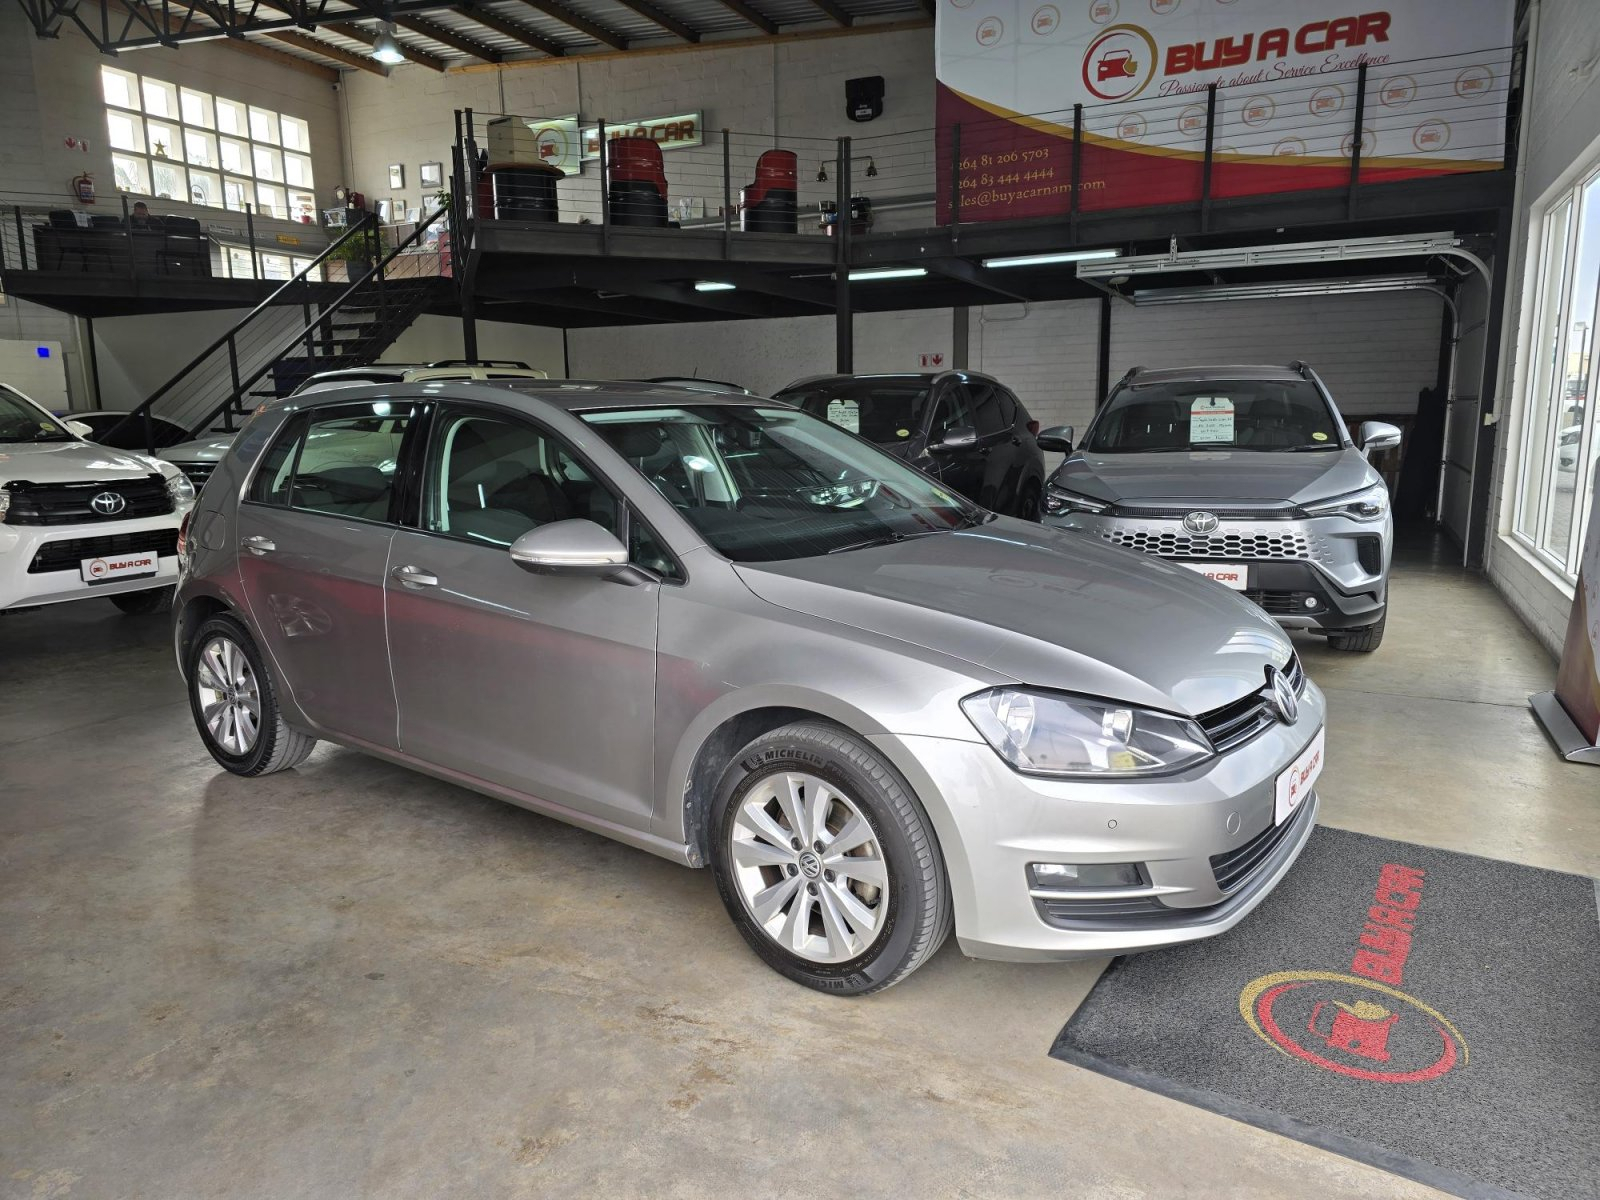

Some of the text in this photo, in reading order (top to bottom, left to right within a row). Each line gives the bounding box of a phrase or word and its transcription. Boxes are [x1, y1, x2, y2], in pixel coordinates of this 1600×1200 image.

[1164, 11, 1391, 76] BUY A CAR
[1158, 52, 1390, 97] Passionte about Service Excellence
[650, 120, 695, 143] CAR
[981, 154, 993, 166] 81
[997, 152, 1018, 164] 206
[1022, 148, 1049, 161] 5703
[981, 174, 994, 185] 83
[998, 173, 1020, 184] 444
[1024, 167, 1054, 181] 4444
[948, 179, 1105, 208] sles@buyacarnamcom
[109, 562, 127, 570] BUY
[1215, 573, 1239, 581] CAR
[764, 749, 824, 765] MICHELIN
